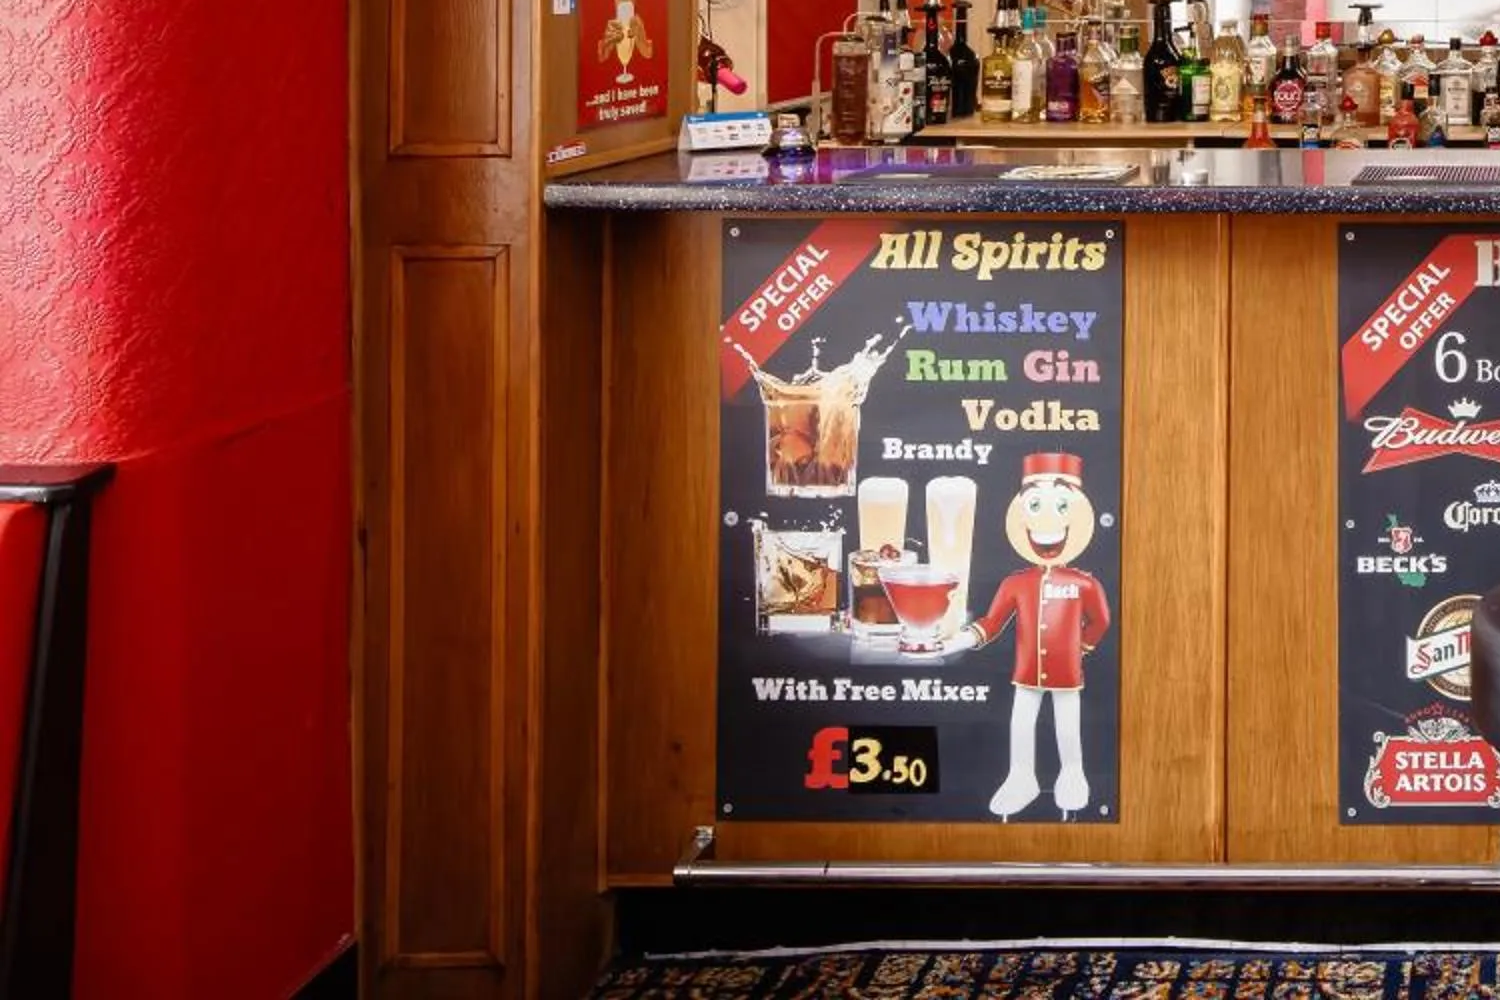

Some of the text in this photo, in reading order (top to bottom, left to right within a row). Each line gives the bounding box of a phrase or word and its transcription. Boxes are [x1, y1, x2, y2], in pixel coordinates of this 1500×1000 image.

[871, 230, 1108, 281] All Spirits
[739, 241, 830, 333] SPECIAL
[777, 272, 835, 332] OFFER
[907, 301, 1097, 340] Whiskey
[1361, 261, 1451, 352] SPECIAL
[1399, 292, 1457, 350] OFFER
[905, 349, 1101, 382] Rum Gin
[1435, 331, 1468, 384] 6
[962, 400, 1101, 431] Vodka
[882, 437, 993, 465] Brandy
[1357, 553, 1448, 574] BECK'S
[1043, 583, 1079, 599] Bach
[1410, 641, 1455, 675] San
[752, 677, 991, 701] With Free Mixer
[804, 727, 928, 789] £3.50
[1395, 751, 1485, 770] STELLA
[1395, 773, 1486, 792] ARTOIS
